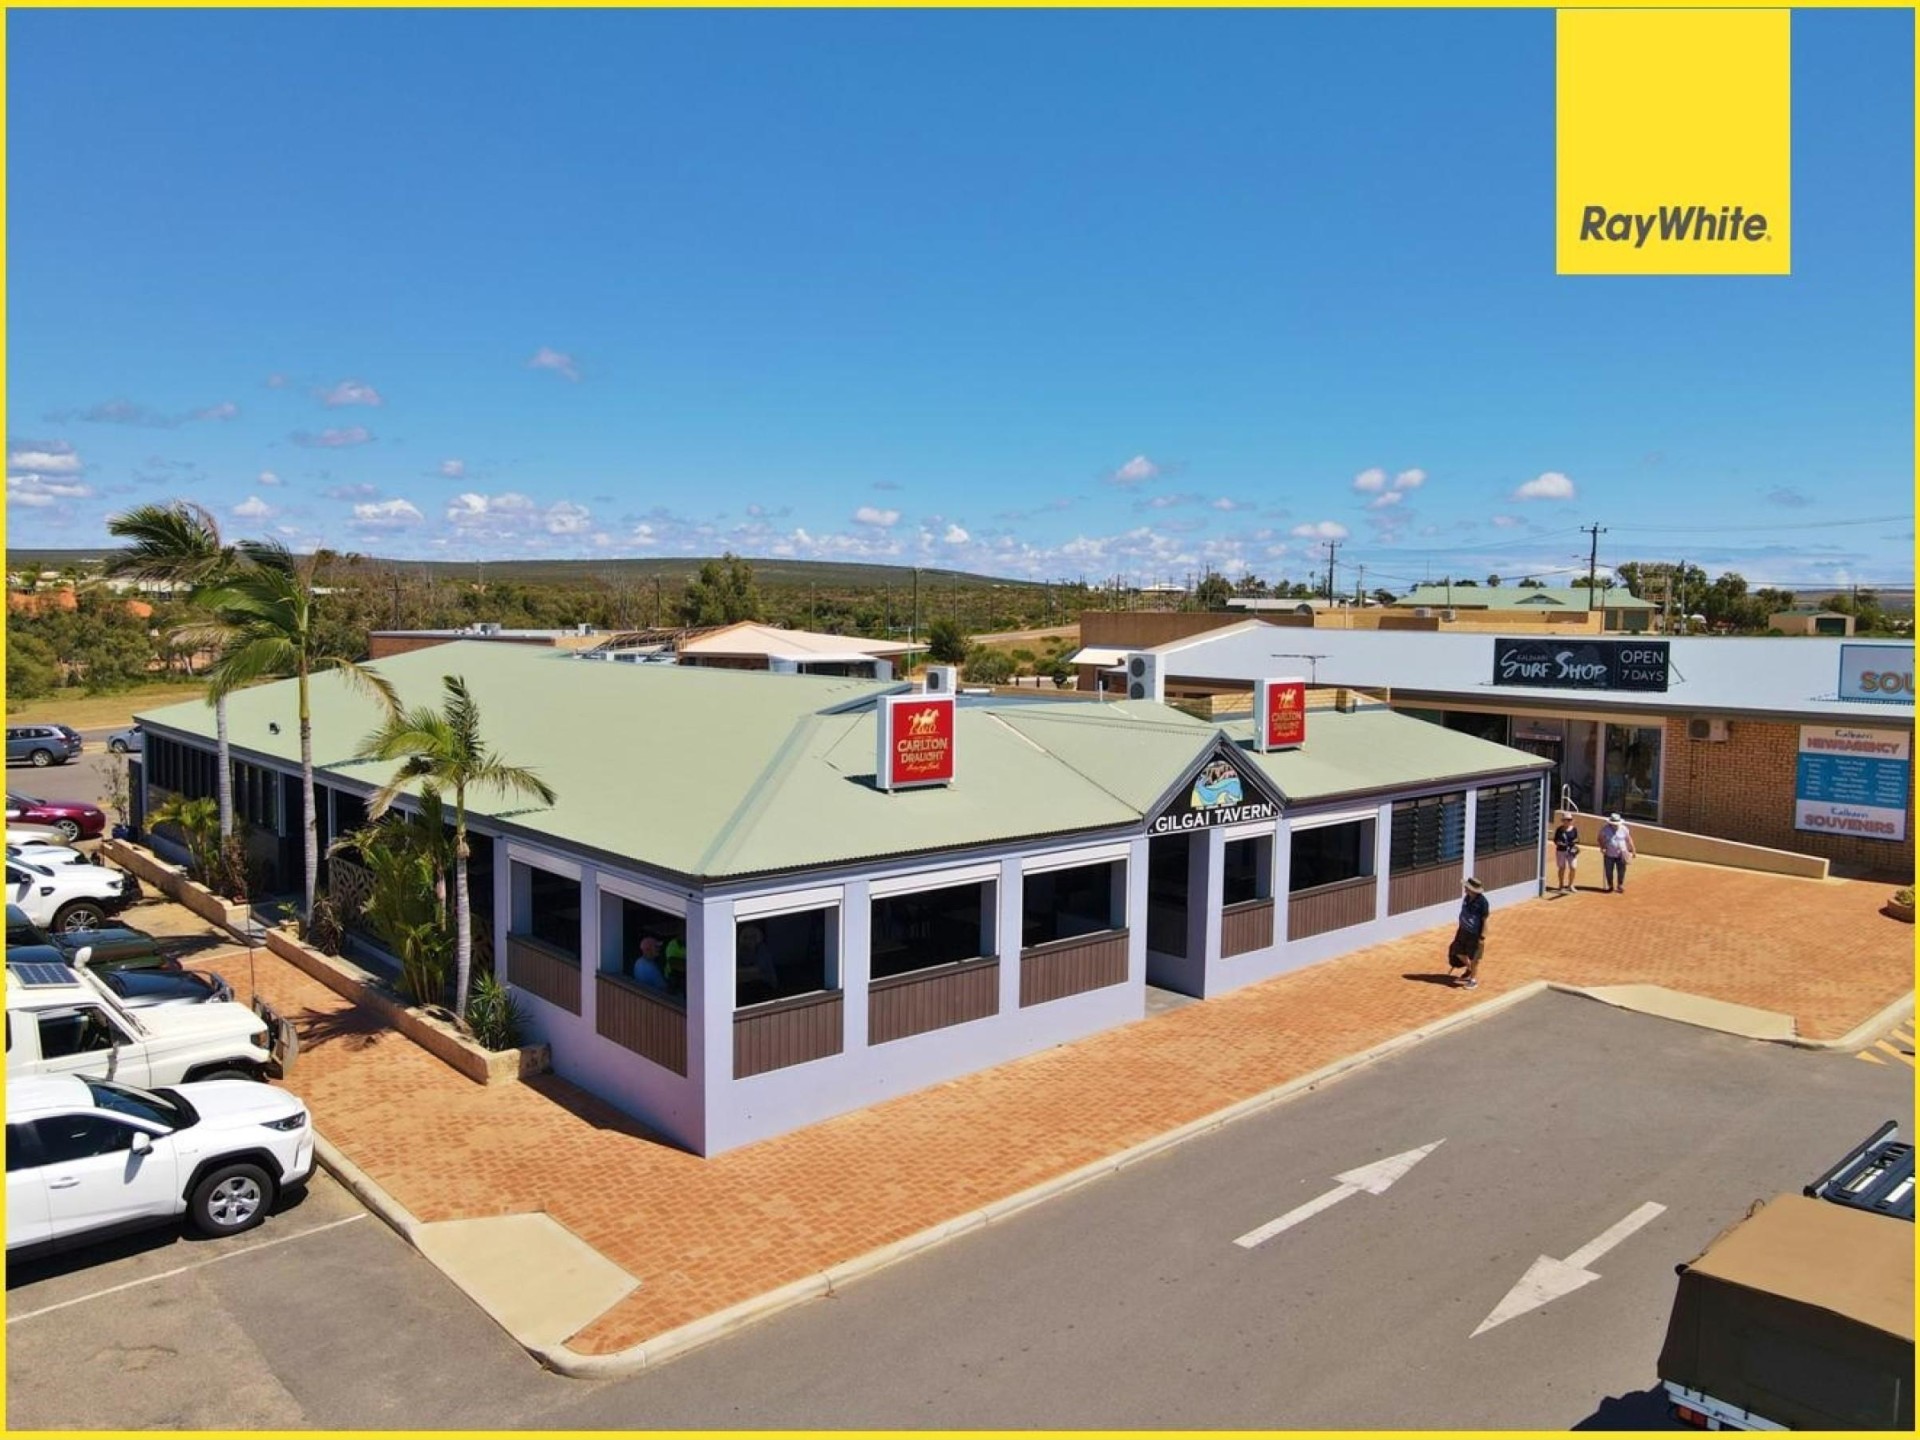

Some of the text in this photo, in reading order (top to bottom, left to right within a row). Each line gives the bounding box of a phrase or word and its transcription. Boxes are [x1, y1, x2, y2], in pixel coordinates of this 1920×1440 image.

[1500, 649, 1608, 681] SURF SHOP
[1620, 650, 1664, 664] OPEN
[1621, 670, 1665, 682] 7 DAYS
[897, 738, 948, 753] CARLTON
[1807, 738, 1899, 754] NEWSAGENCY
[901, 748, 945, 764] DRAUGHT
[1155, 803, 1272, 832] GILGAI TAVERN
[1804, 814, 1895, 834] SOUVENIRS
